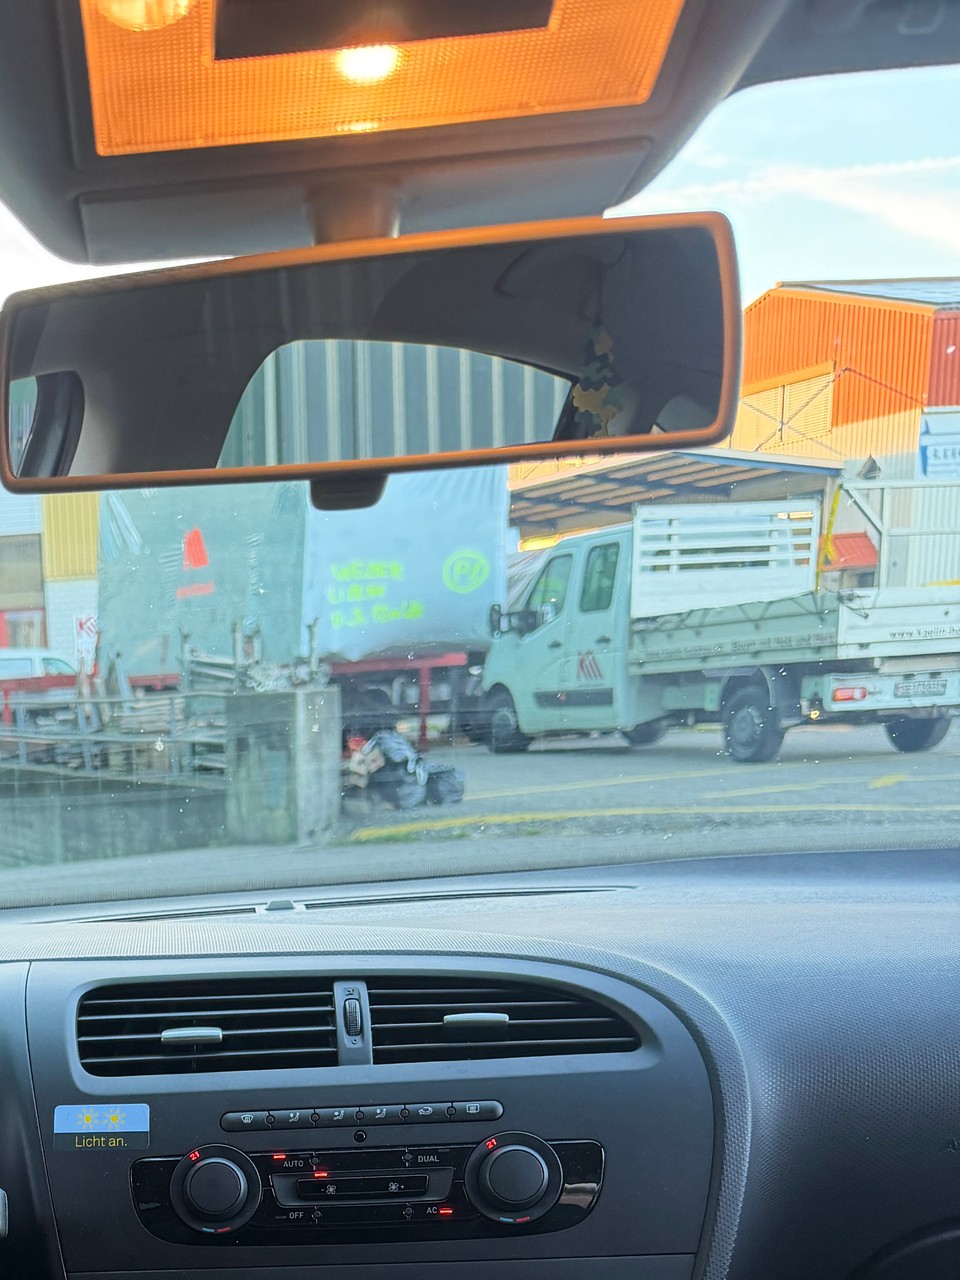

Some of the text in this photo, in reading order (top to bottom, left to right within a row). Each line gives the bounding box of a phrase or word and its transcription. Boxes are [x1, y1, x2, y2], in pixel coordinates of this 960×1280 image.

[75, 1135, 128, 1148] Licht an.
[418, 1155, 440, 1163] DUAL
[283, 1160, 304, 1168] AUTO
[426, 1206, 438, 1214] AC
[289, 1212, 304, 1220] OFF
